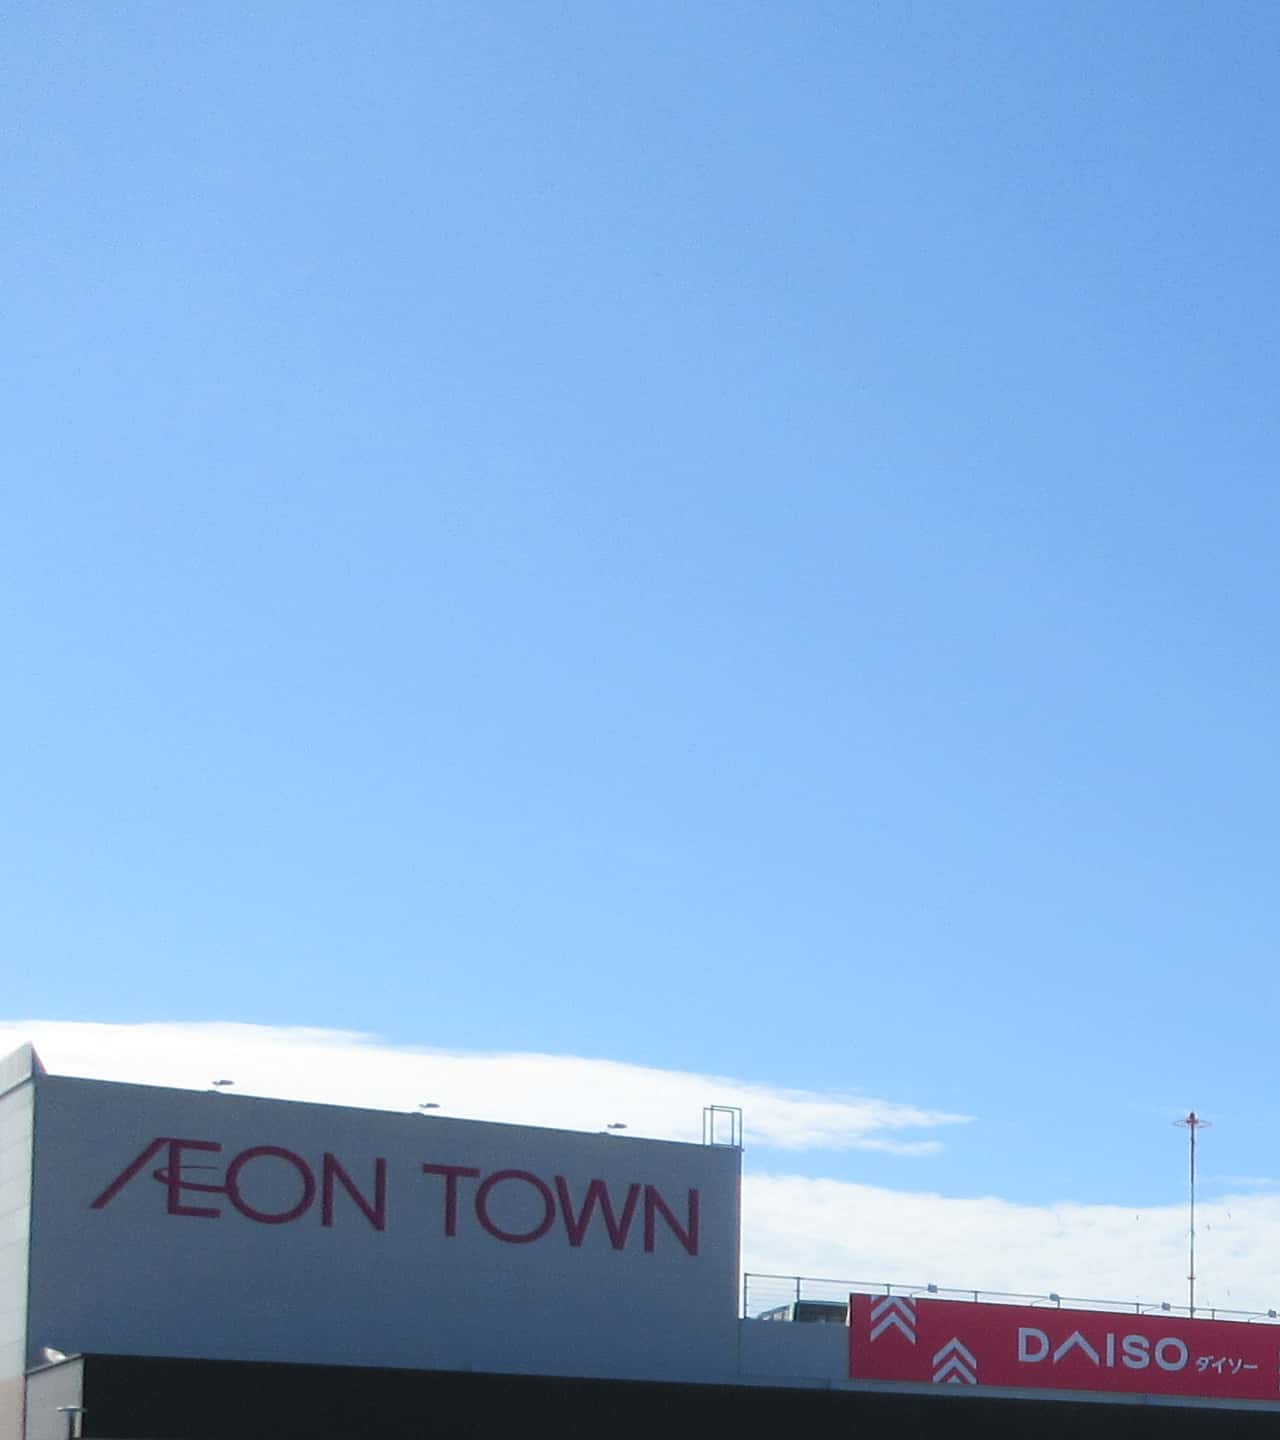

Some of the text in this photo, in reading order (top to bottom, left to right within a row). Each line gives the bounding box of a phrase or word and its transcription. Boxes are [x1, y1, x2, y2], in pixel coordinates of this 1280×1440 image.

[422, 1162, 699, 1256] TOWN
[1017, 1327, 1259, 1375] DAISO ダイソー
